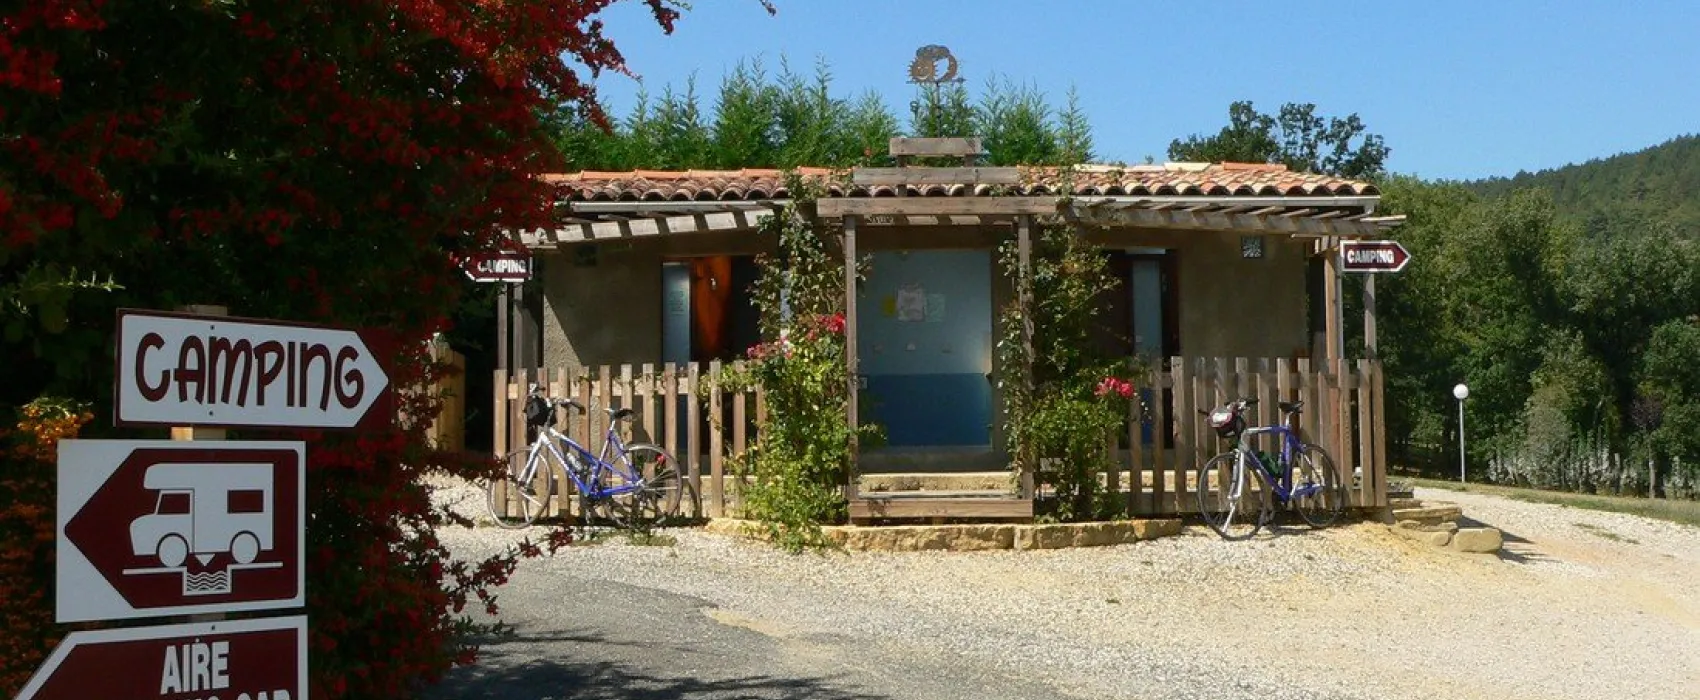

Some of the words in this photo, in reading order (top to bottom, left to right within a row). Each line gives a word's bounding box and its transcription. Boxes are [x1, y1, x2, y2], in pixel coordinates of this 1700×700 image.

[1347, 249, 1395, 264] CAMPING
[135, 332, 364, 411] CAMPING
[160, 641, 230, 695] AIRE
